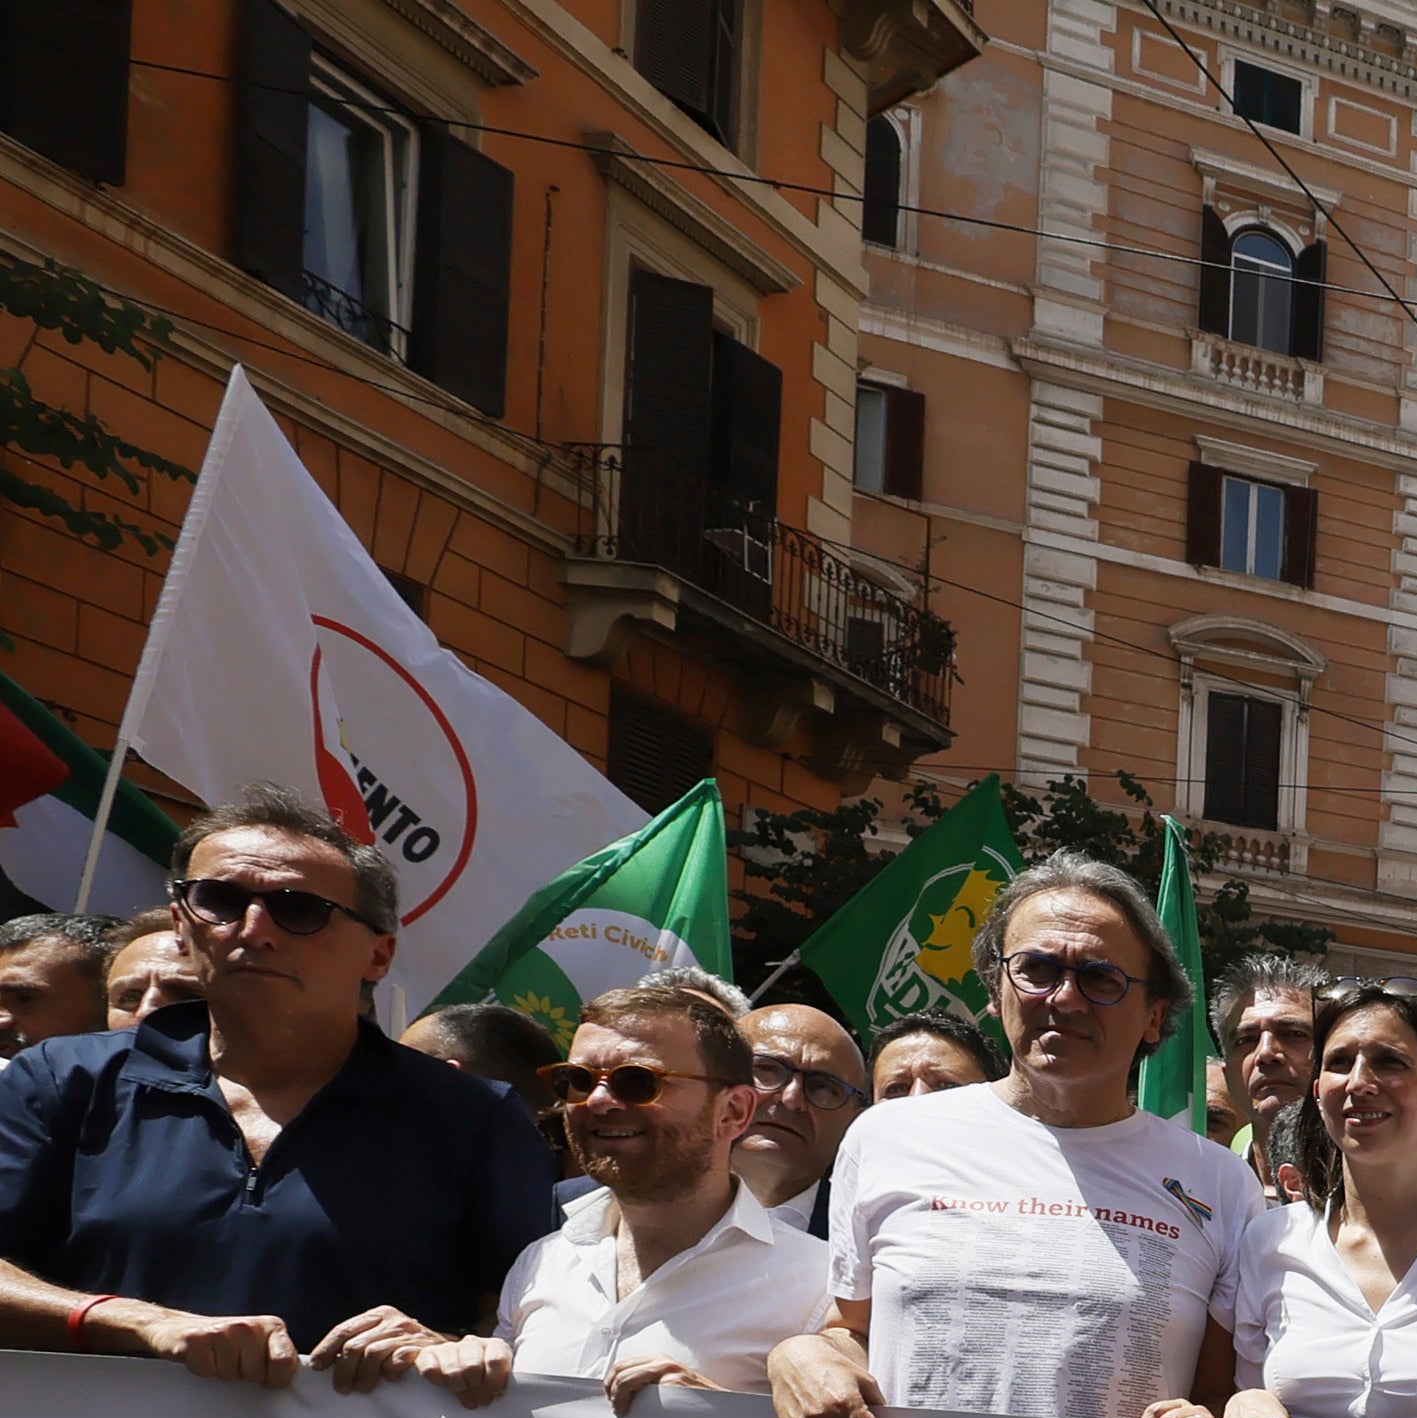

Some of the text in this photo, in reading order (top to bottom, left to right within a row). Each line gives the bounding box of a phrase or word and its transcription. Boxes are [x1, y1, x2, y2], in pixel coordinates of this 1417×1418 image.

[930, 1195, 1180, 1240] Know their names
